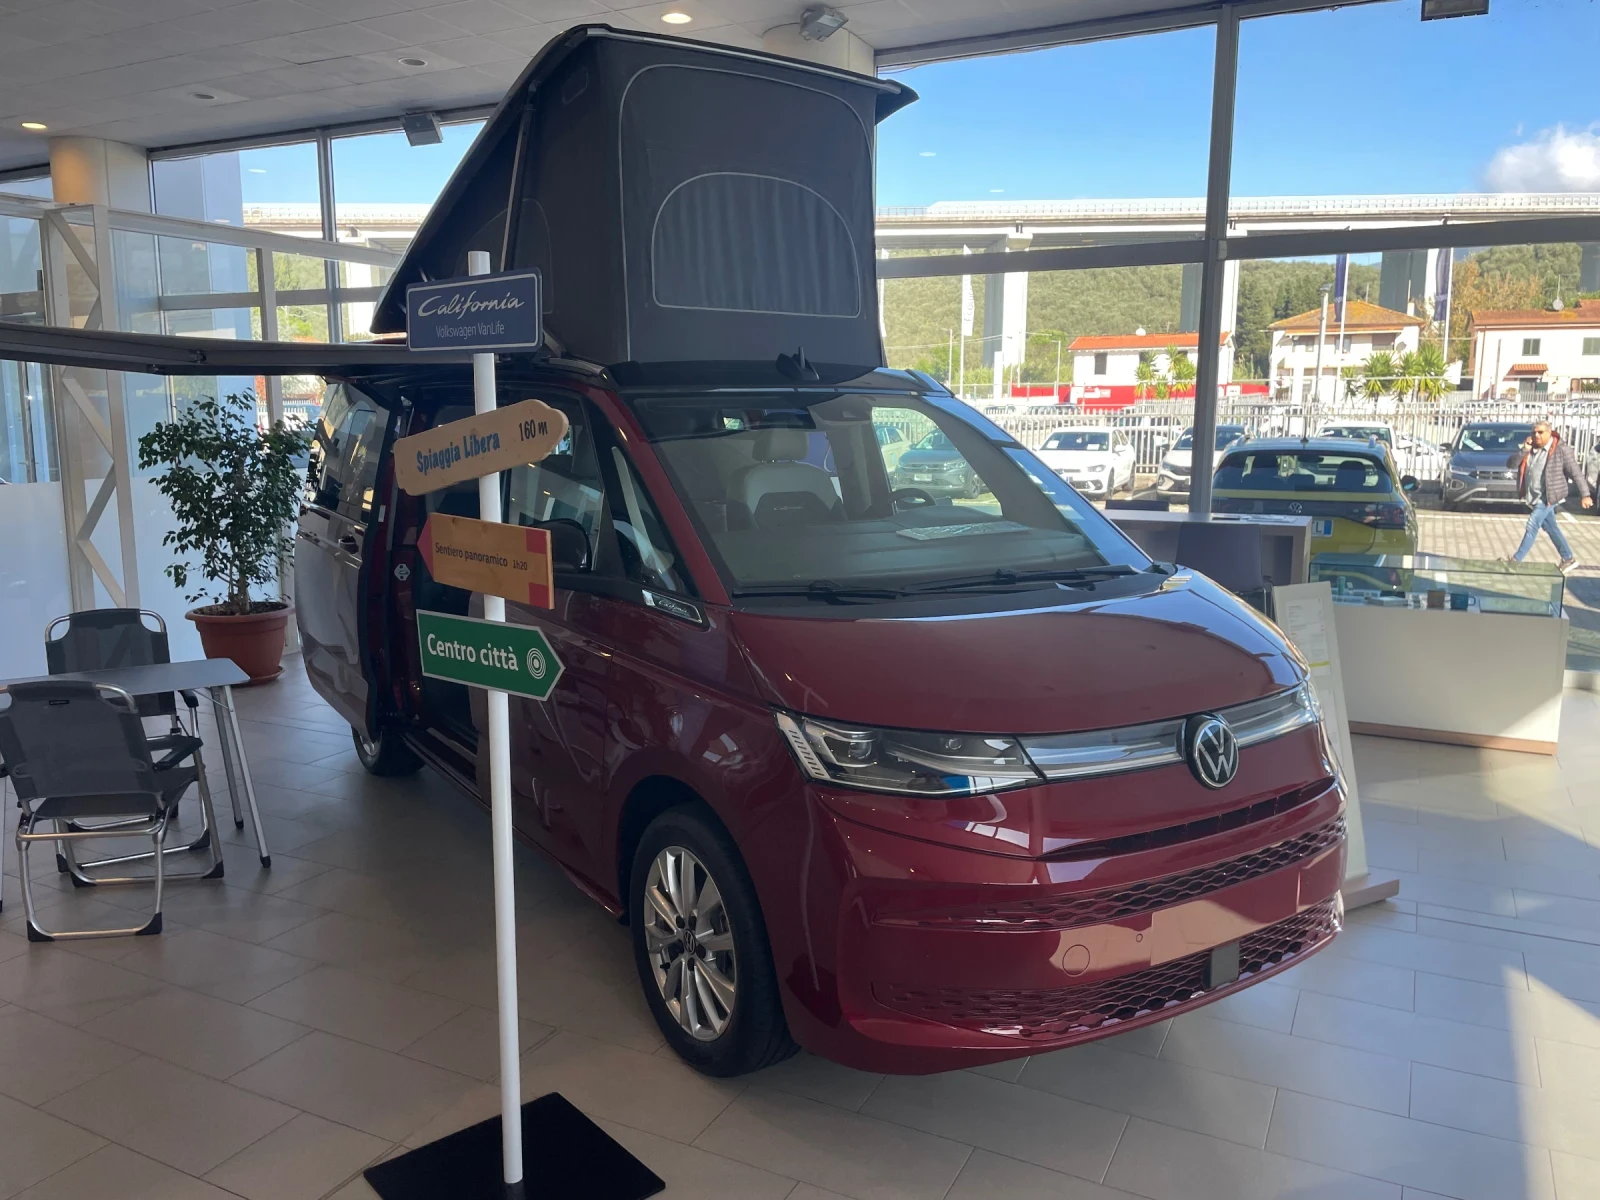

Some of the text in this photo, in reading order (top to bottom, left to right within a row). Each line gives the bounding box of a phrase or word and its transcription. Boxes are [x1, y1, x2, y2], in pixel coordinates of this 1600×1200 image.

[418, 291, 525, 319] California
[436, 321, 505, 339] Volkswagen VanLife
[519, 419, 548, 442] 160 m
[416, 432, 500, 475] Spiaggia Libera
[435, 543, 528, 571] Sentiero panoramico 1h20
[427, 633, 518, 671] Centro città
[1196, 722, 1237, 785] VW
